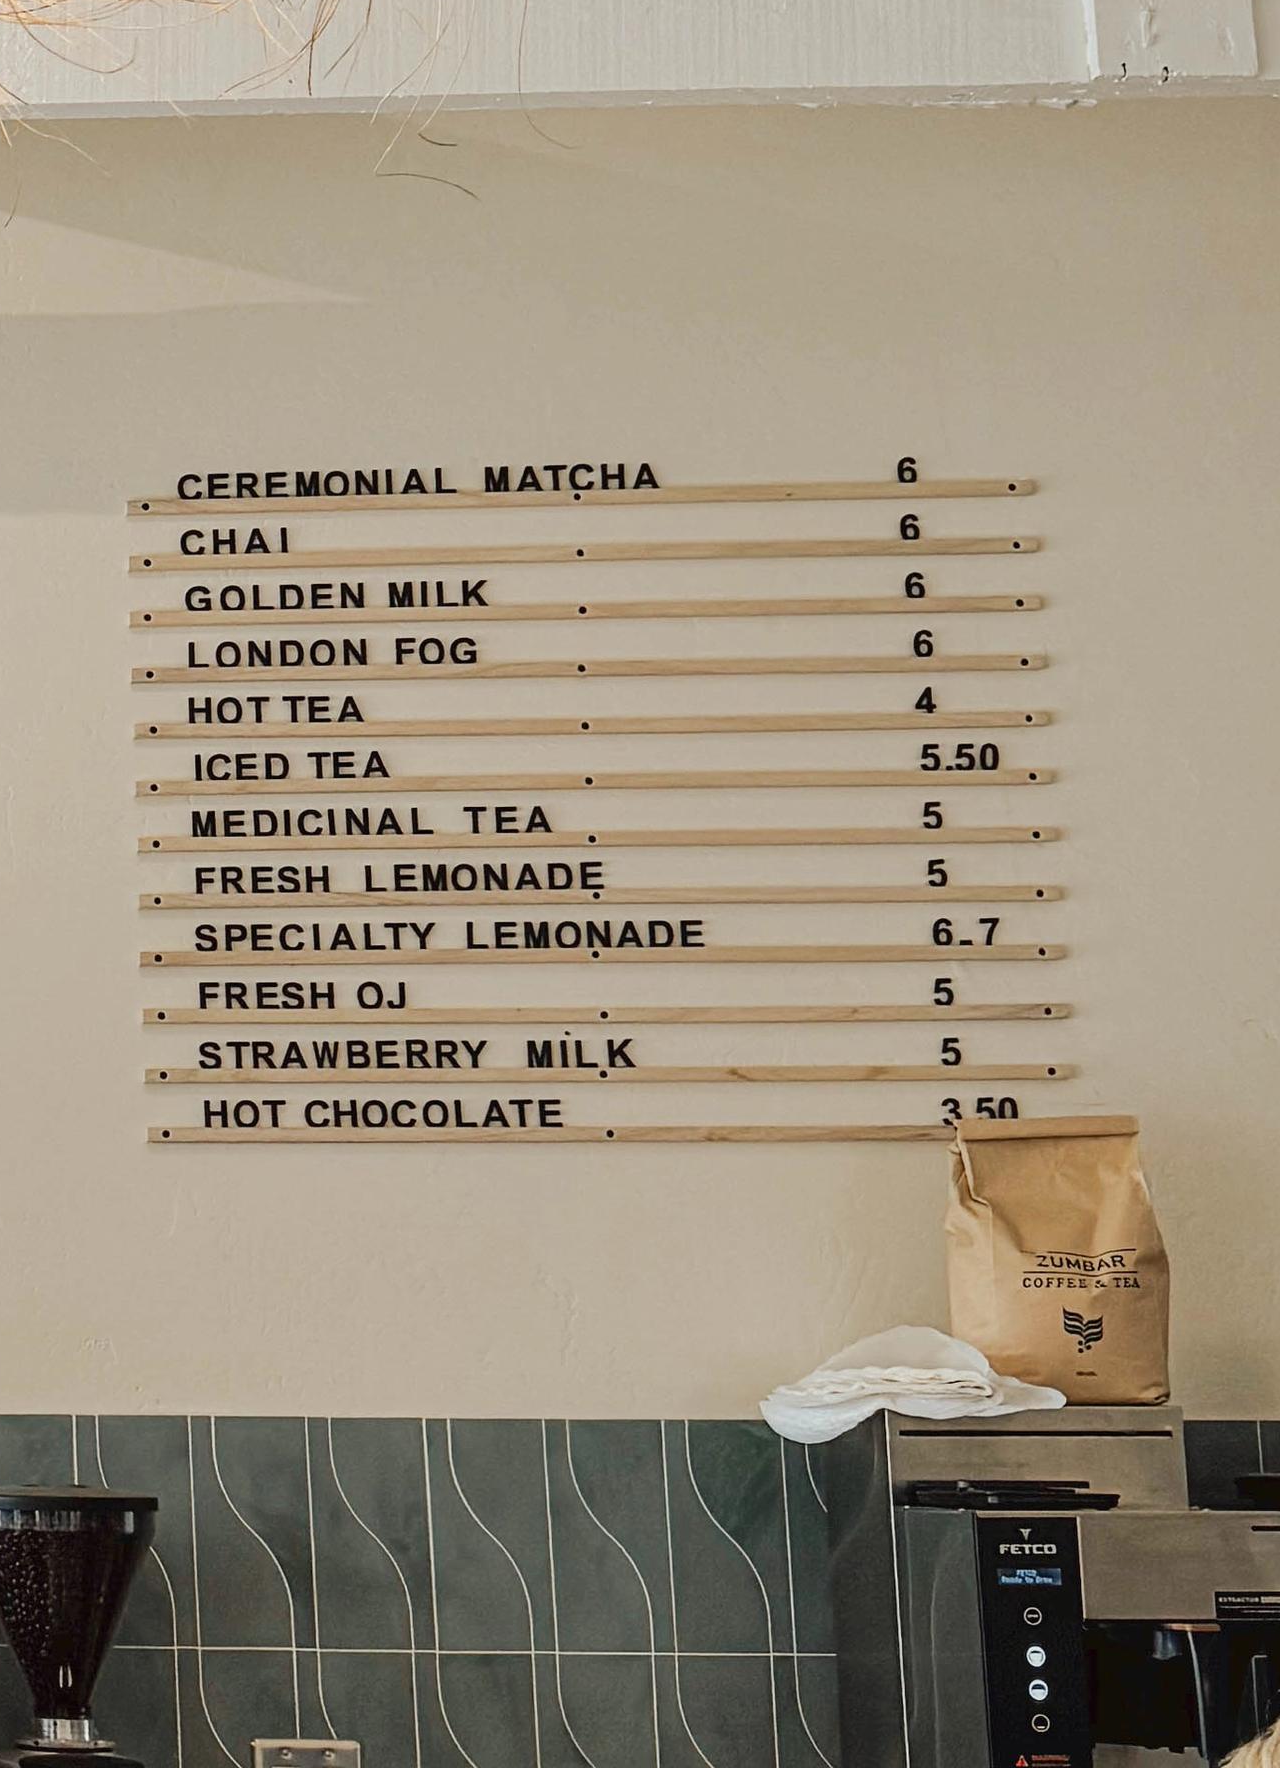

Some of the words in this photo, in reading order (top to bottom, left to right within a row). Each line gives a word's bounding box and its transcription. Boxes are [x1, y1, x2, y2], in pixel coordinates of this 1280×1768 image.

[177, 467, 458, 501] CEREMONIAL
[484, 462, 661, 493] MATCHA
[896, 456, 918, 484] 6
[180, 527, 289, 556] CHAI
[899, 513, 921, 541] 6
[184, 582, 366, 612] GOLDEN
[387, 579, 489, 608] MILK
[904, 571, 926, 599] 6
[188, 638, 368, 669] LONDON
[395, 637, 478, 666] FOG
[913, 629, 934, 658] 6
[188, 696, 271, 725] HOT
[281, 695, 365, 724] TEA
[914, 686, 938, 714] 4
[194, 752, 290, 782] ICED
[306, 750, 391, 780] TEA
[920, 742, 1000, 772] 5.50
[191, 807, 435, 838] MEDICINAL
[462, 805, 554, 835] TEA
[922, 801, 944, 830] 5
[195, 865, 331, 895] FRESH
[364, 861, 605, 893] LEMONADE
[927, 858, 948, 888] 5
[194, 922, 436, 952] SPECIALTY
[466, 919, 706, 950] LEMONADE
[198, 981, 336, 1010] FRESH
[356, 981, 406, 1010] OJ
[933, 977, 955, 1007] 5
[198, 1039, 488, 1070] STRAWBERRY
[526, 1038, 637, 1069] MILK
[941, 1037, 962, 1067] 5
[203, 1099, 287, 1129] HOT
[304, 1098, 564, 1129] CHOCOLATE
[941, 1097, 1019, 1121] 350
[1035, 1254, 1126, 1272] ZUMBAR
[1022, 1277, 1089, 1289] COFFEE
[1094, 1279, 1108, 1289] &
[1112, 1277, 1141, 1289] TEA
[998, 1543, 1058, 1555] FETCO
